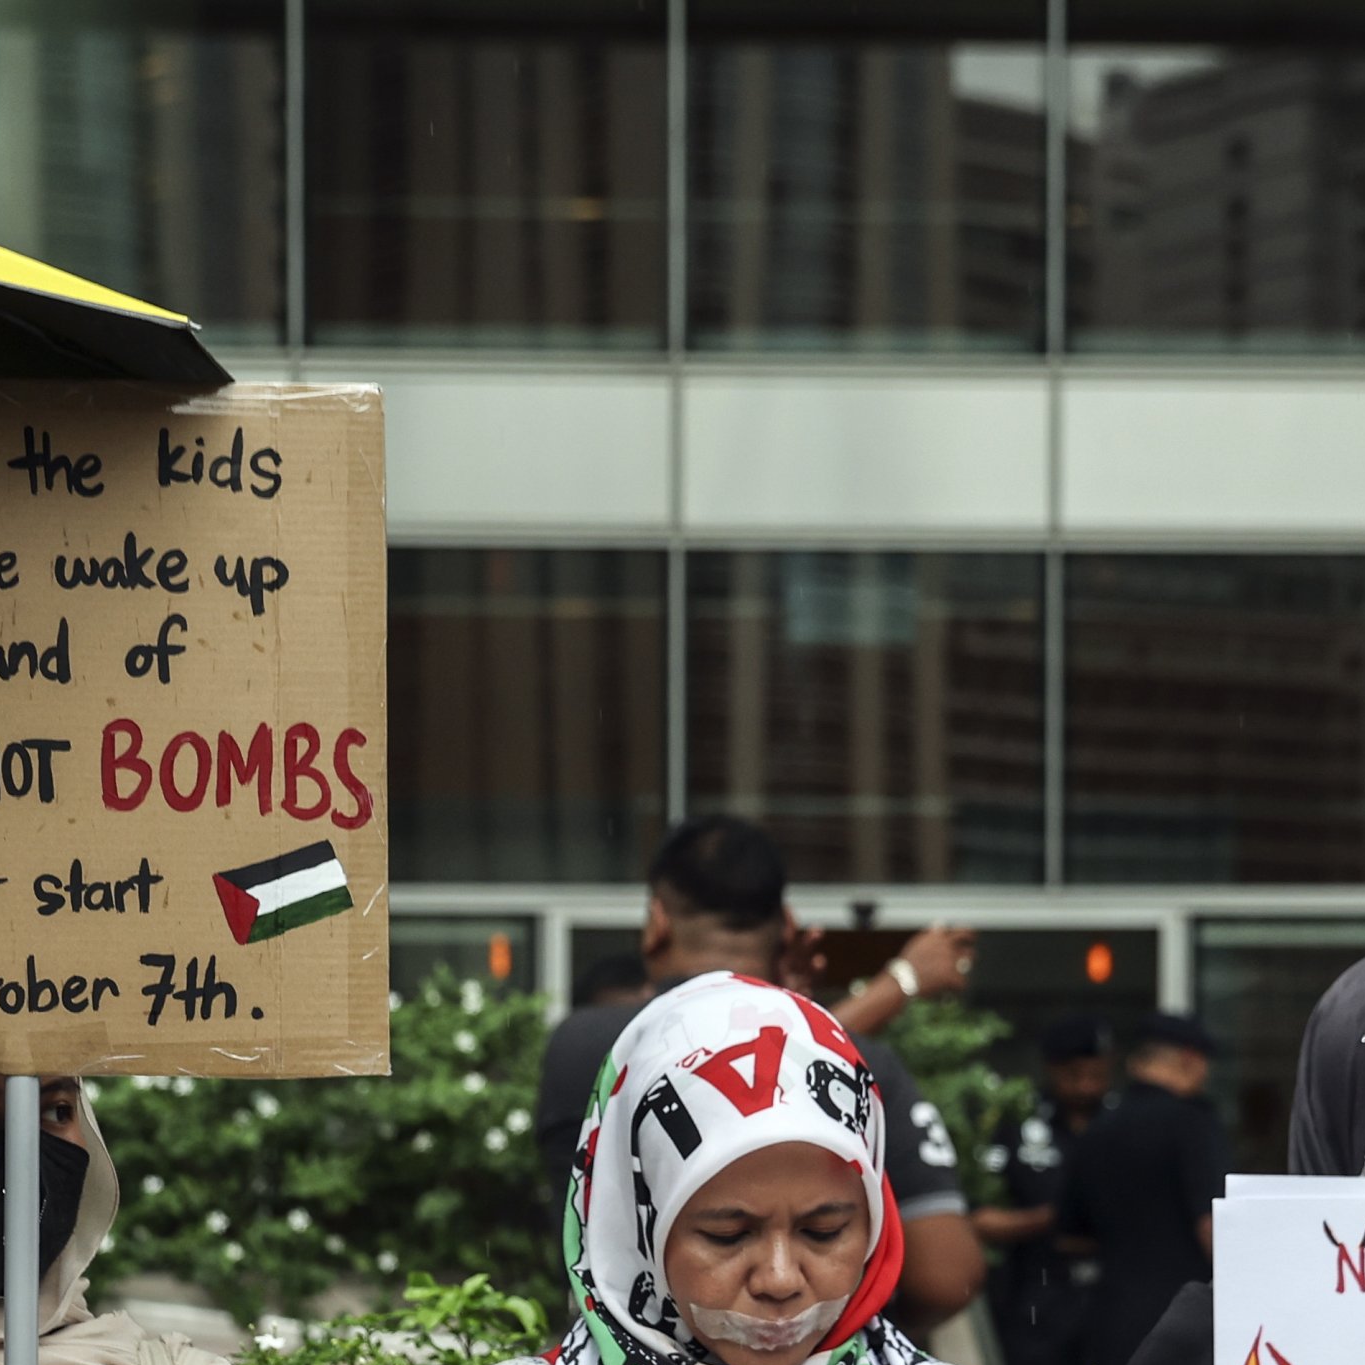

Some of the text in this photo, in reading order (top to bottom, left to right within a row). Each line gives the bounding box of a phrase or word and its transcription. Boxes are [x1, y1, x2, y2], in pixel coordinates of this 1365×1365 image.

[8, 426, 104, 496] the
[158, 427, 282, 498] kids
[54, 532, 190, 595] wake
[214, 552, 290, 616] up
[125, 613, 188, 683] of
[101, 718, 374, 830] BOMBS
[34, 858, 163, 915] start
[139, 953, 264, 1026] 7th.
